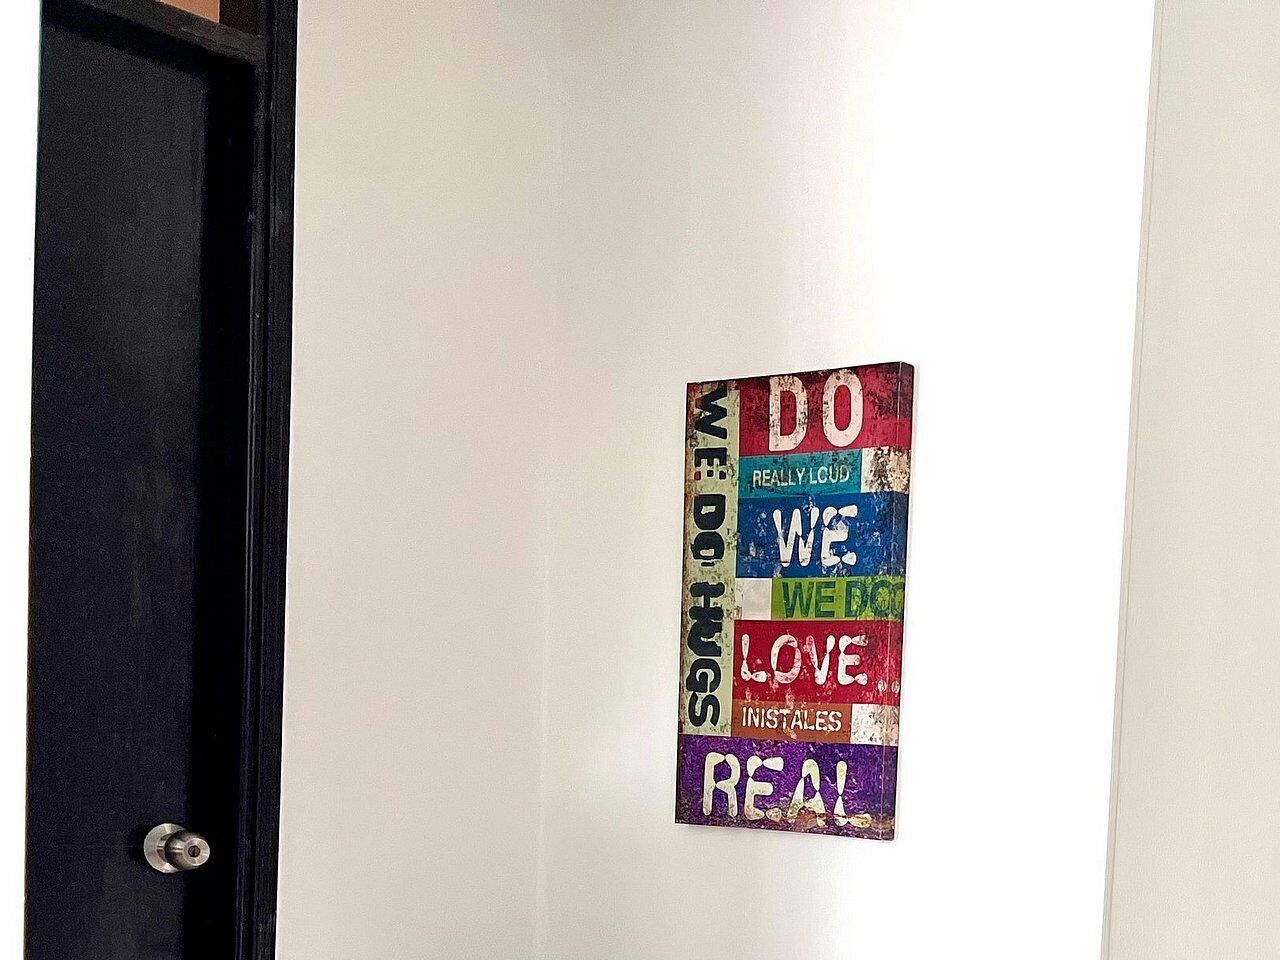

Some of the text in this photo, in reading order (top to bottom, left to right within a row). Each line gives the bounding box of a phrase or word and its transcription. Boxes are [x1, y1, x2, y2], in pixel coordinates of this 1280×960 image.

[769, 369, 863, 451] DO
[752, 464, 850, 488] REALLY LOUD
[686, 382, 728, 727] WE DO HUGS
[772, 504, 858, 567] WE
[782, 580, 893, 618] WE DO
[740, 633, 869, 686] LOVE
[742, 706, 842, 732] INISTALES
[702, 752, 872, 828] REAL
